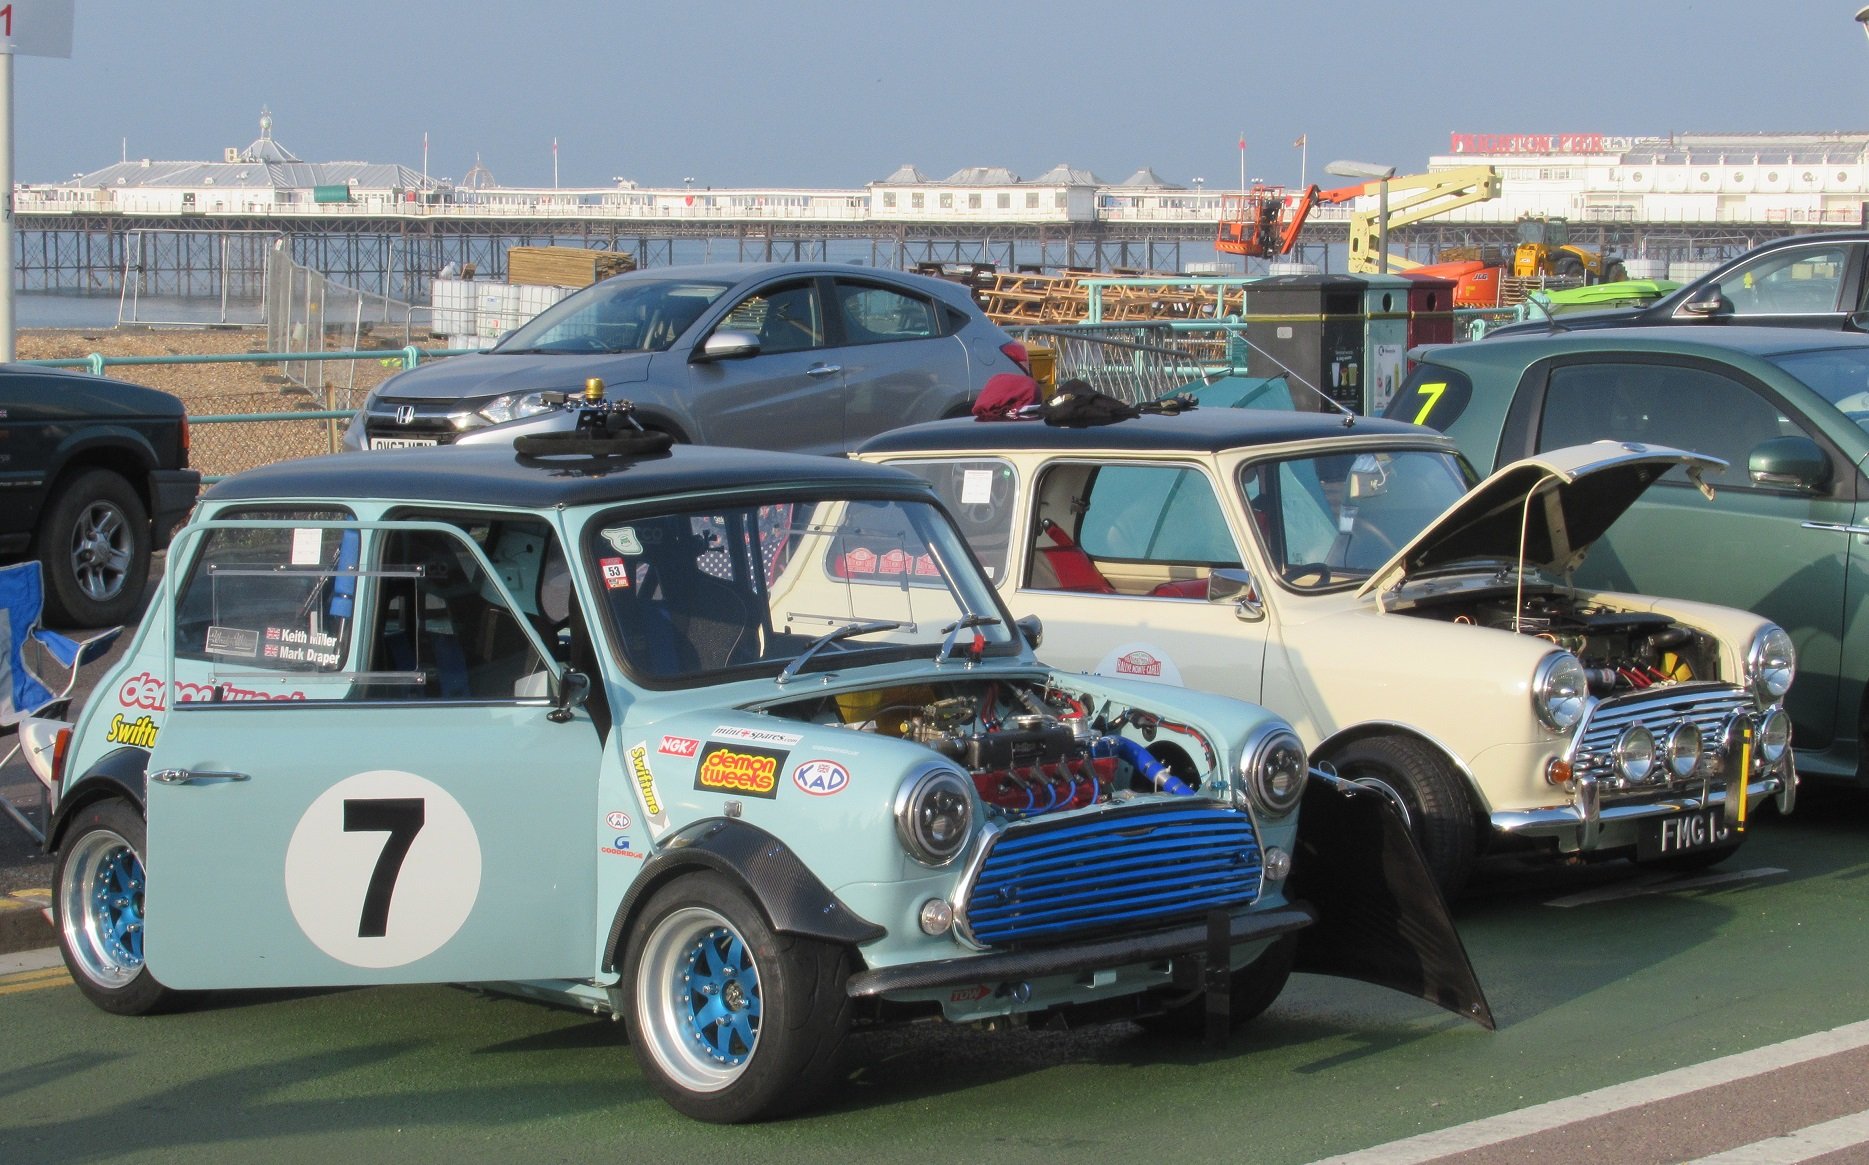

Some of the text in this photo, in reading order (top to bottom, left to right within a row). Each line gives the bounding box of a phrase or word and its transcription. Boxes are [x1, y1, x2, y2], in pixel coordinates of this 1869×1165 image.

[1413, 382, 1447, 427] 7
[608, 566, 621, 577] 53
[281, 628, 307, 644] Keith
[280, 645, 340, 666] Mark Draper
[715, 726, 742, 736] mini
[660, 737, 690, 753] NGK
[707, 749, 776, 774] demon
[631, 747, 659, 814] Swiftune
[701, 767, 774, 792] tweeks
[797, 764, 845, 791] KAD
[608, 814, 630, 827] KAD
[1661, 815, 1705, 852] FMG
[601, 847, 643, 859] GOODRIDGE
[343, 797, 425, 938] 7
